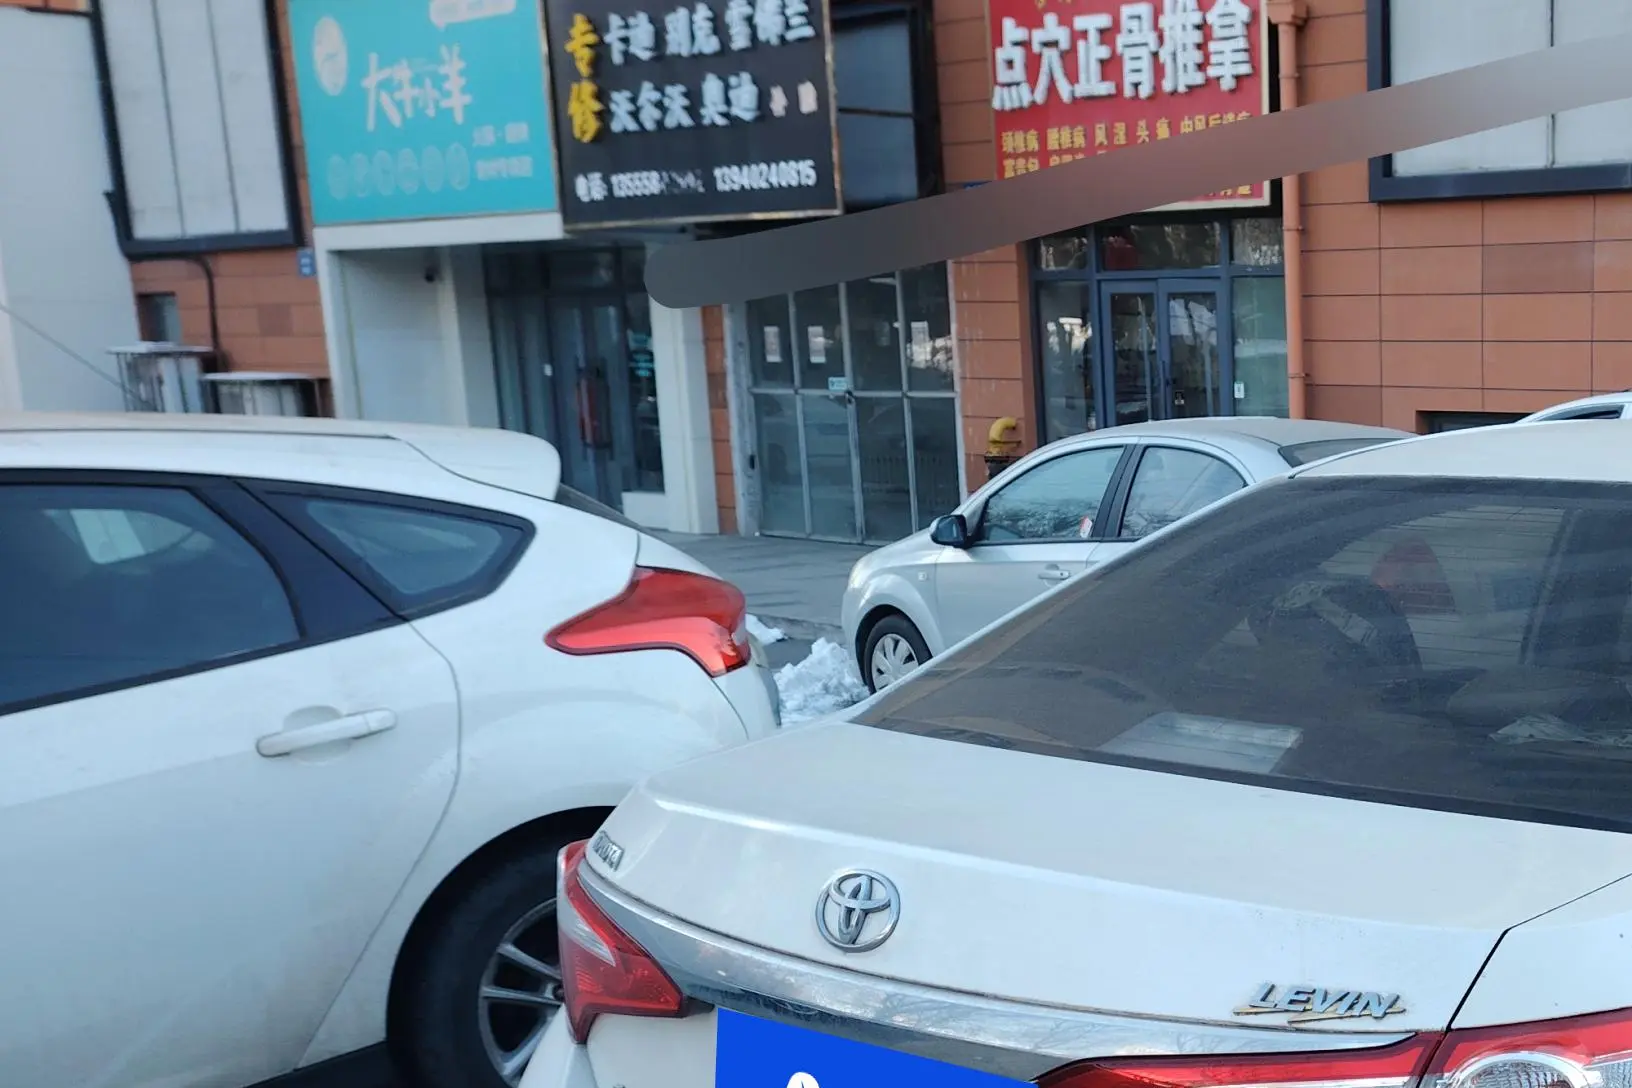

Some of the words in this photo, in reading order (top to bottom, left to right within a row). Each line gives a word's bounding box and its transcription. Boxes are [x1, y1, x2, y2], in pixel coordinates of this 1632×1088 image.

[992, 0, 1253, 111] 点穴正骨推拿
[609, 80, 695, 133] 沃尔沃
[699, 71, 761, 126] 奥迪
[1249, 982, 1402, 1019] LEVIN
